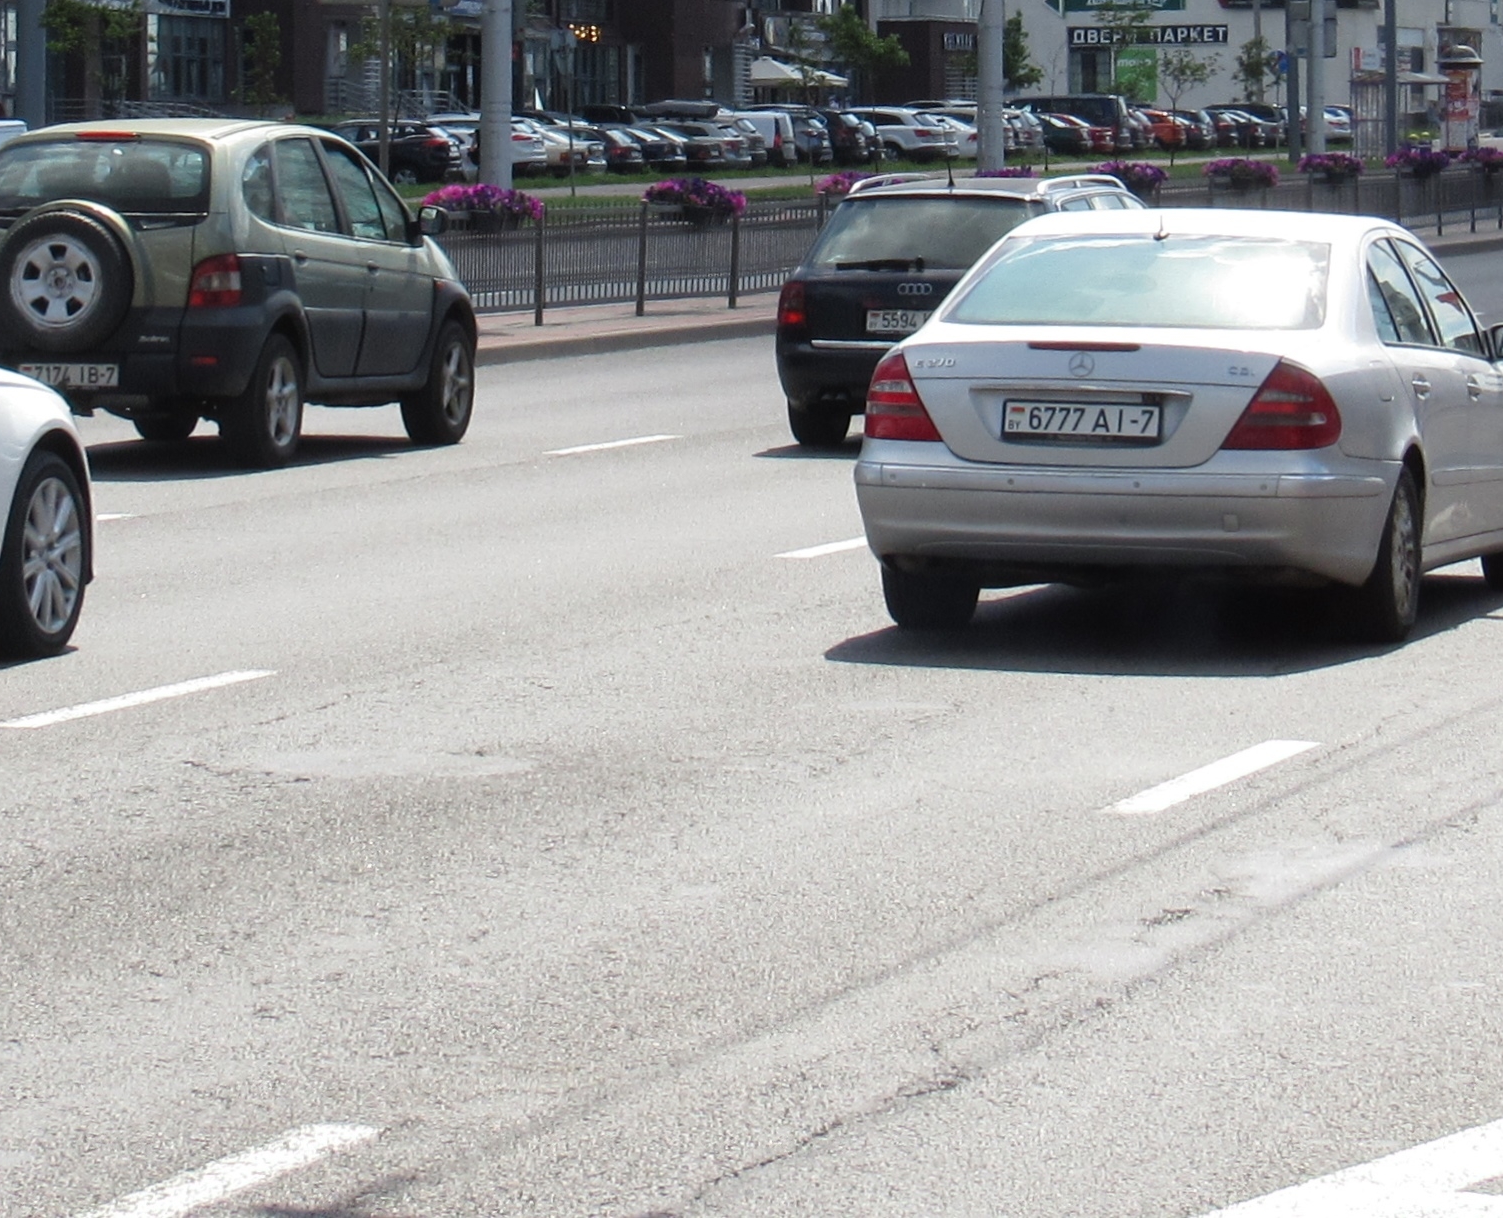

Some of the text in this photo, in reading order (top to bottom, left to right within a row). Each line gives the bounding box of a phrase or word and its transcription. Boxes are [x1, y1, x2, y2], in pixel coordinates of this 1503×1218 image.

[1149, 26, 1227, 43] ПАРКЕТ
[882, 313, 918, 329] 5594
[80, 366, 116, 384] IB-7
[1007, 419, 1021, 430] BY
[1028, 406, 1086, 432] 6777
